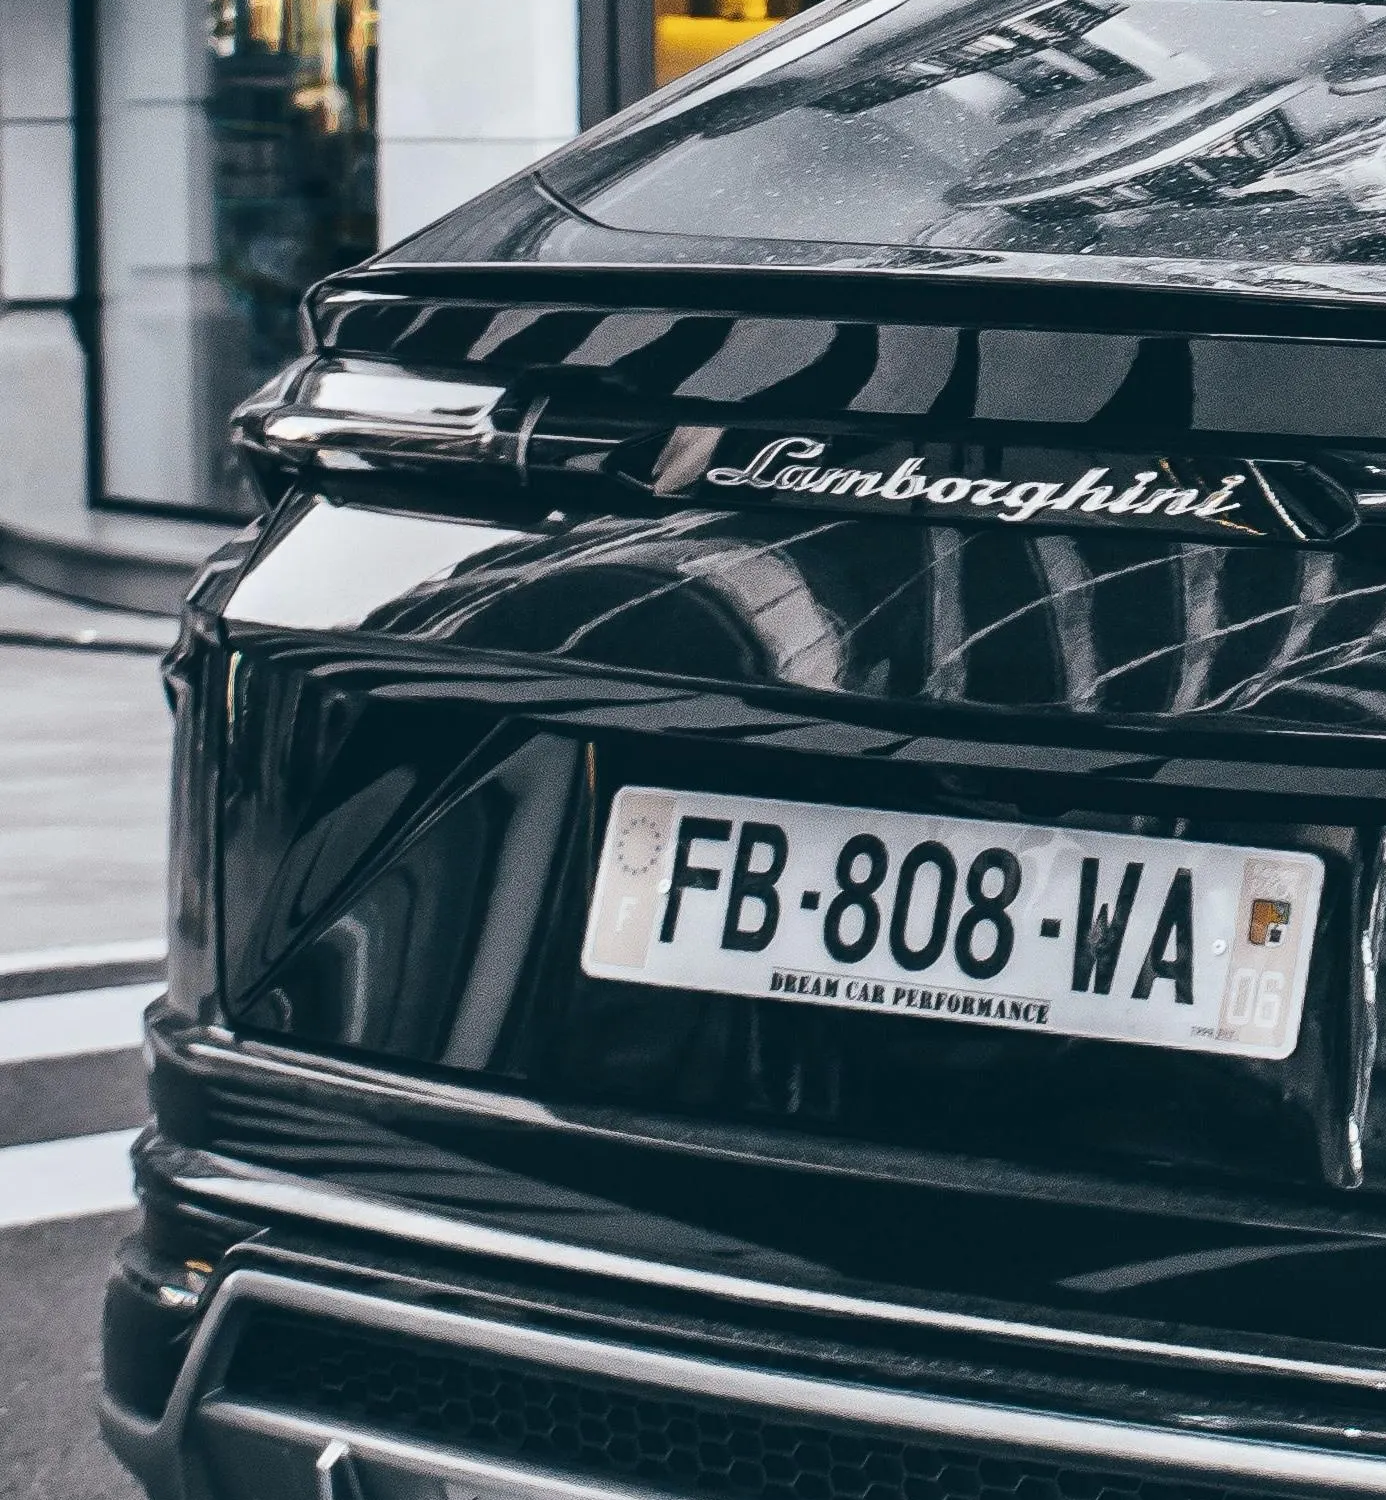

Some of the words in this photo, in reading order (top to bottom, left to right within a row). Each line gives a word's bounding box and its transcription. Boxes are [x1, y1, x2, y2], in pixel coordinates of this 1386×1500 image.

[706, 436, 1246, 522] Lamborghini
[615, 895, 637, 933] F
[659, 815, 1194, 1005] FB-808-WA
[770, 971, 839, 998] DREAM
[845, 981, 885, 1004] CAR
[892, 986, 1049, 1025] PERFORMANCE
[1226, 967, 1285, 1028] 06
